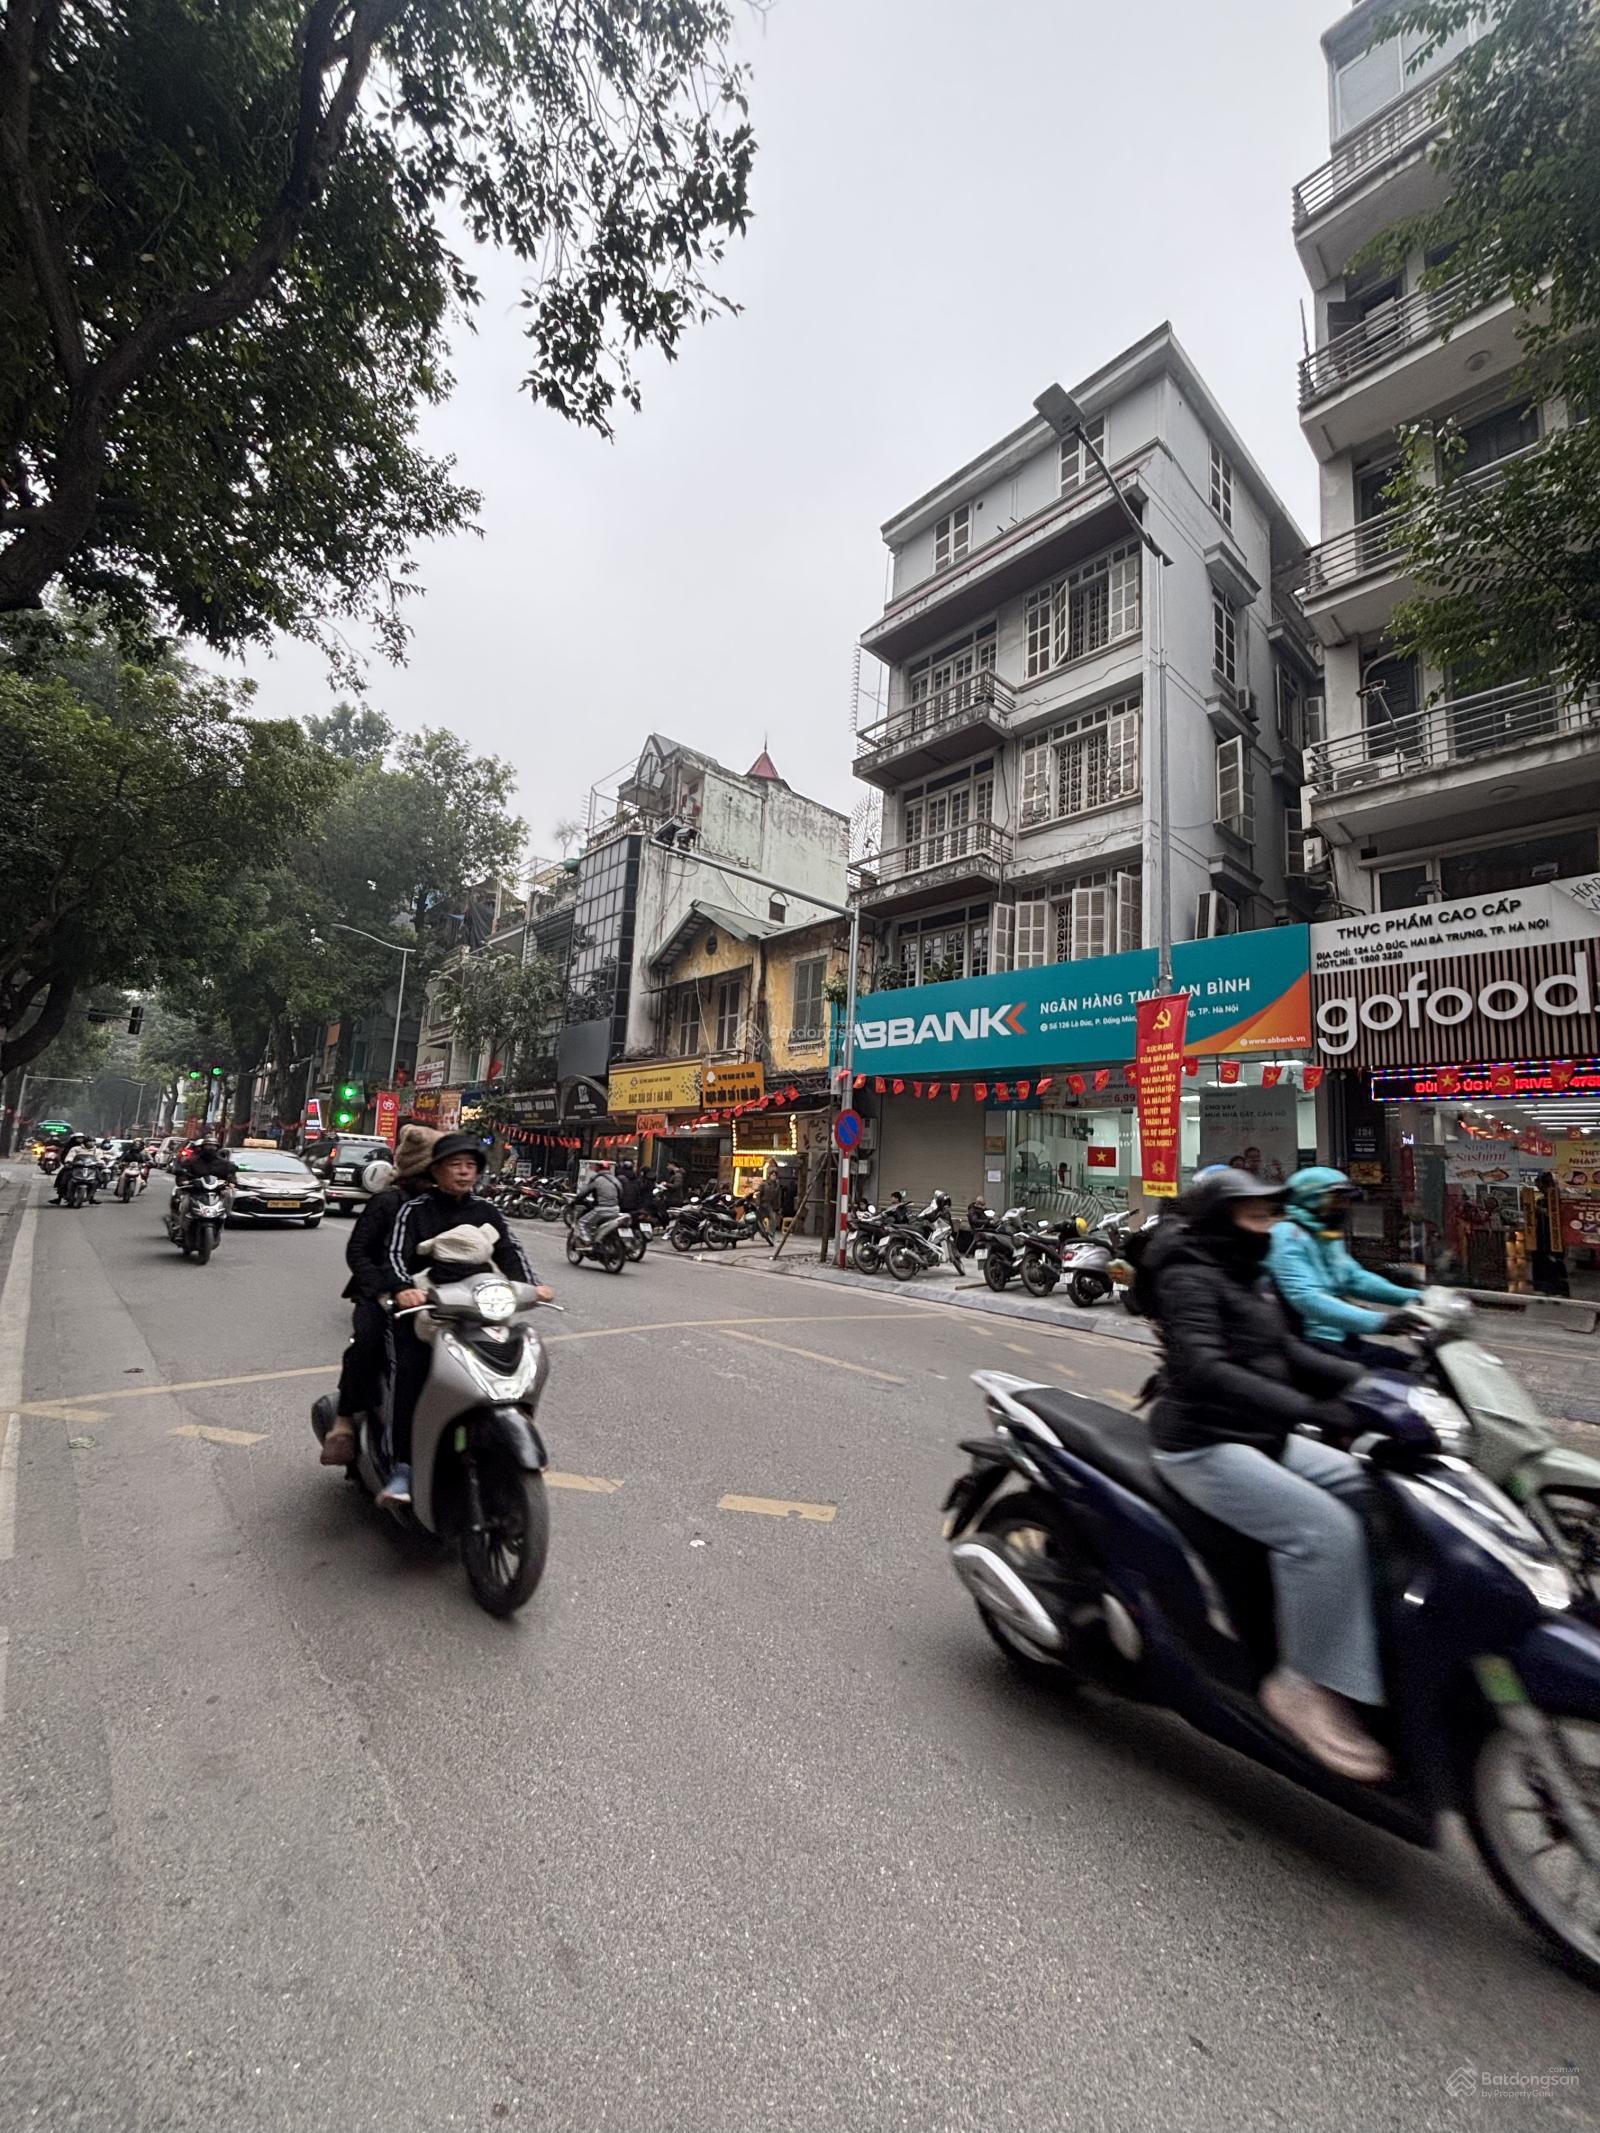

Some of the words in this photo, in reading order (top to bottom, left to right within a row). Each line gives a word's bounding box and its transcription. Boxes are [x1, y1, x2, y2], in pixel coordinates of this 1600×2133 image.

[1337, 923, 1381, 940] THỰC
[1385, 913, 1433, 932] PHẨM
[1438, 906, 1477, 924] CAO
[1482, 897, 1522, 917] CẤP
[1316, 951, 1331, 961] ĐỊA
[1353, 946, 1369, 955] 124
[1410, 937, 1427, 947] HAI
[1429, 933, 1444, 945] BÀ
[1445, 927, 1487, 942] TRƯNG,
[1489, 925, 1506, 935] TP.
[1508, 921, 1526, 933] HÀ
[1528, 918, 1549, 931] NỘI
[1316, 956, 1357, 969] HOTLINE:
[1360, 954, 1380, 964] 1900
[1382, 950, 1403, 960] 3220
[1040, 997, 1077, 1015] NGÂN
[1082, 993, 1123, 1009] HÀNG
[1128, 988, 1161, 1004] TMC
[1179, 984, 1201, 997] AN
[1207, 977, 1251, 996] BÌNH
[842, 1004, 1013, 1051] ABBANK
[1058, 1021, 1070, 1029] 126
[1198, 1006, 1210, 1016] TP.
[1212, 1005, 1223, 1014] Hà
[1225, 1003, 1239, 1014] Nội
[1248, 1035, 1306, 1045] www.abbank.vn
[1455, 1151, 1507, 1163] Sashimi
